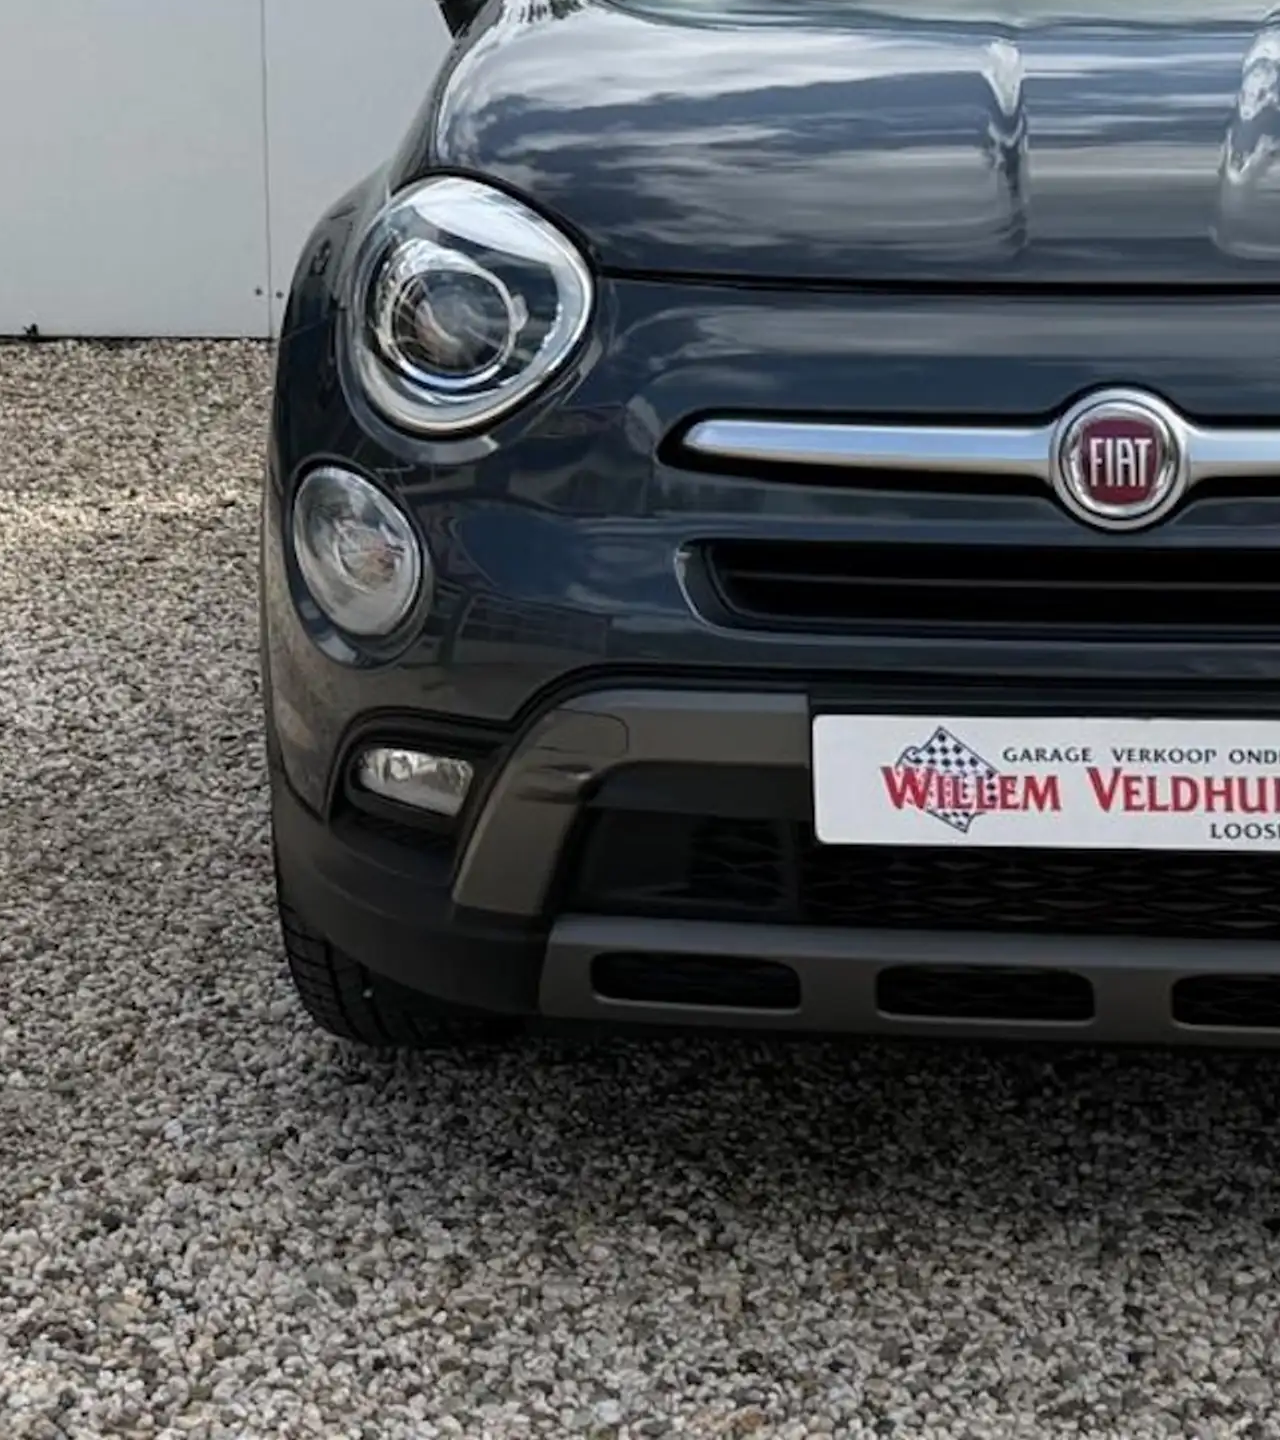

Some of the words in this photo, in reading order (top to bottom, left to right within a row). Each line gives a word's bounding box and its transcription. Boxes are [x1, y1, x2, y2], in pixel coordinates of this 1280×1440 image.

[1089, 437, 1153, 487] FIAT
[1002, 745, 1094, 764] GARAGE
[1110, 747, 1217, 765] VERKOOP
[881, 765, 1061, 813] WILLEM
